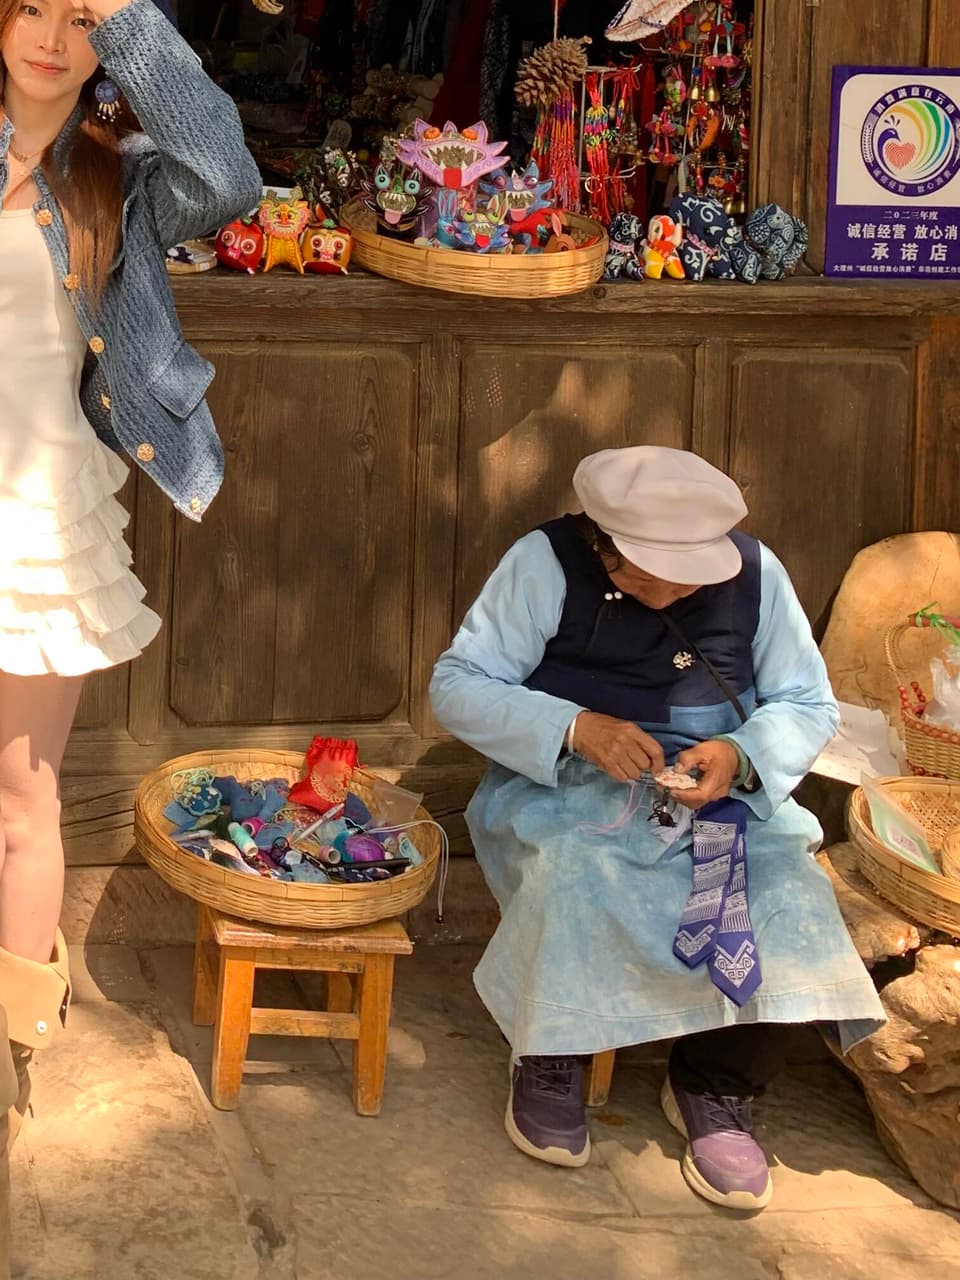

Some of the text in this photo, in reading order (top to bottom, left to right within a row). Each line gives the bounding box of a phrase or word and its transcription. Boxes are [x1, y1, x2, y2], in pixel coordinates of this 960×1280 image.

[846, 223, 958, 240] 诚信经营 放心消
[871, 242, 948, 261] 承诺店
